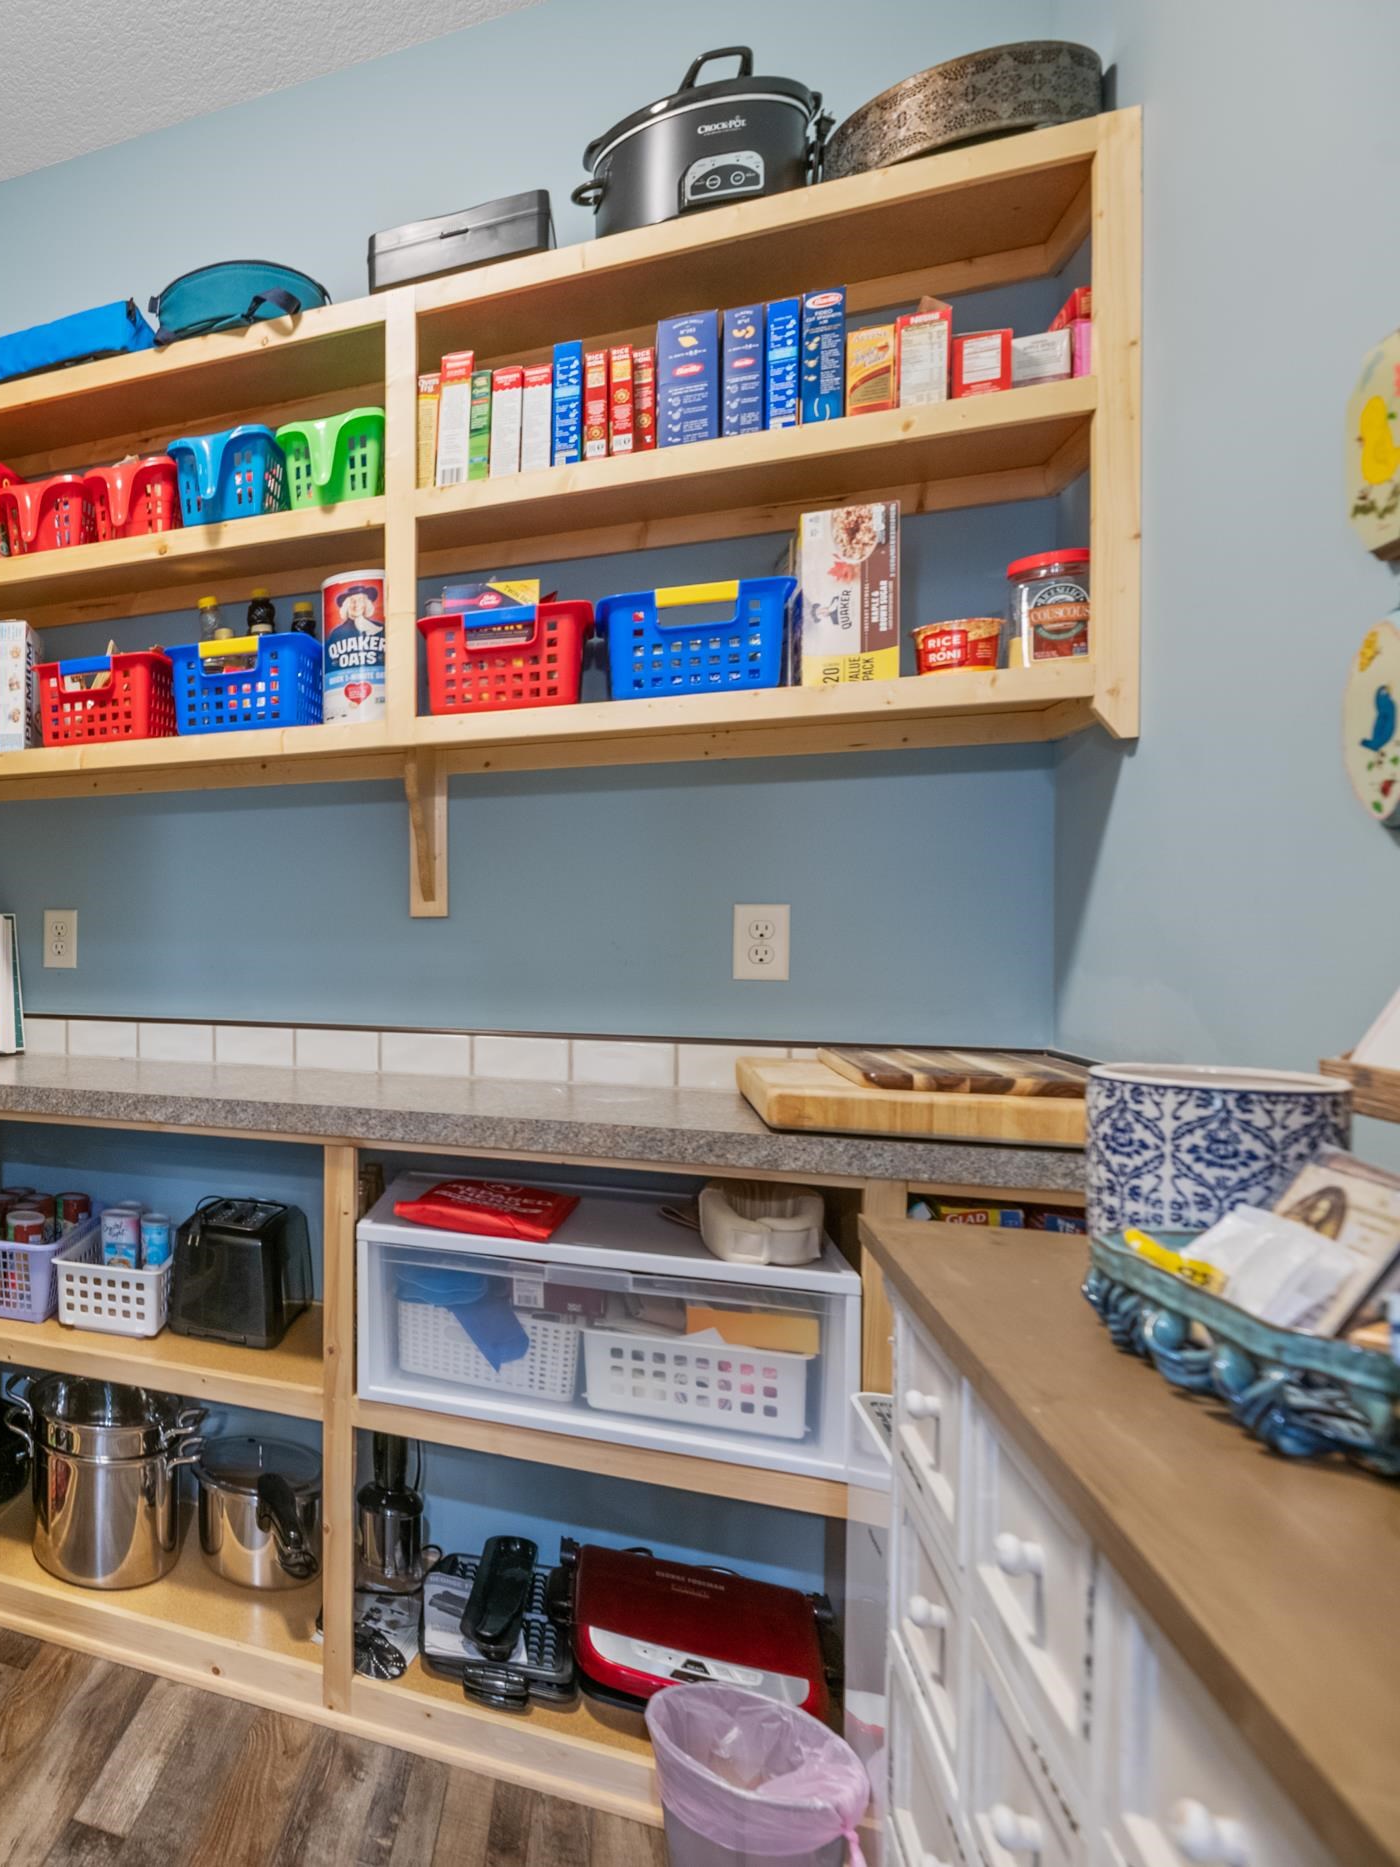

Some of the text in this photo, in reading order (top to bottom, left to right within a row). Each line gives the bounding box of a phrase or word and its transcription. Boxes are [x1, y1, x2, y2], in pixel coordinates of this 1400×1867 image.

[842, 589, 852, 630] QUAKER
[927, 634, 961, 648] RICE
[339, 651, 377, 668] OATS
[928, 649, 962, 663] RONI
[822, 667, 840, 684] 20
[862, 656, 875, 682] PACK
[25, 640, 33, 742] PREMIUM
